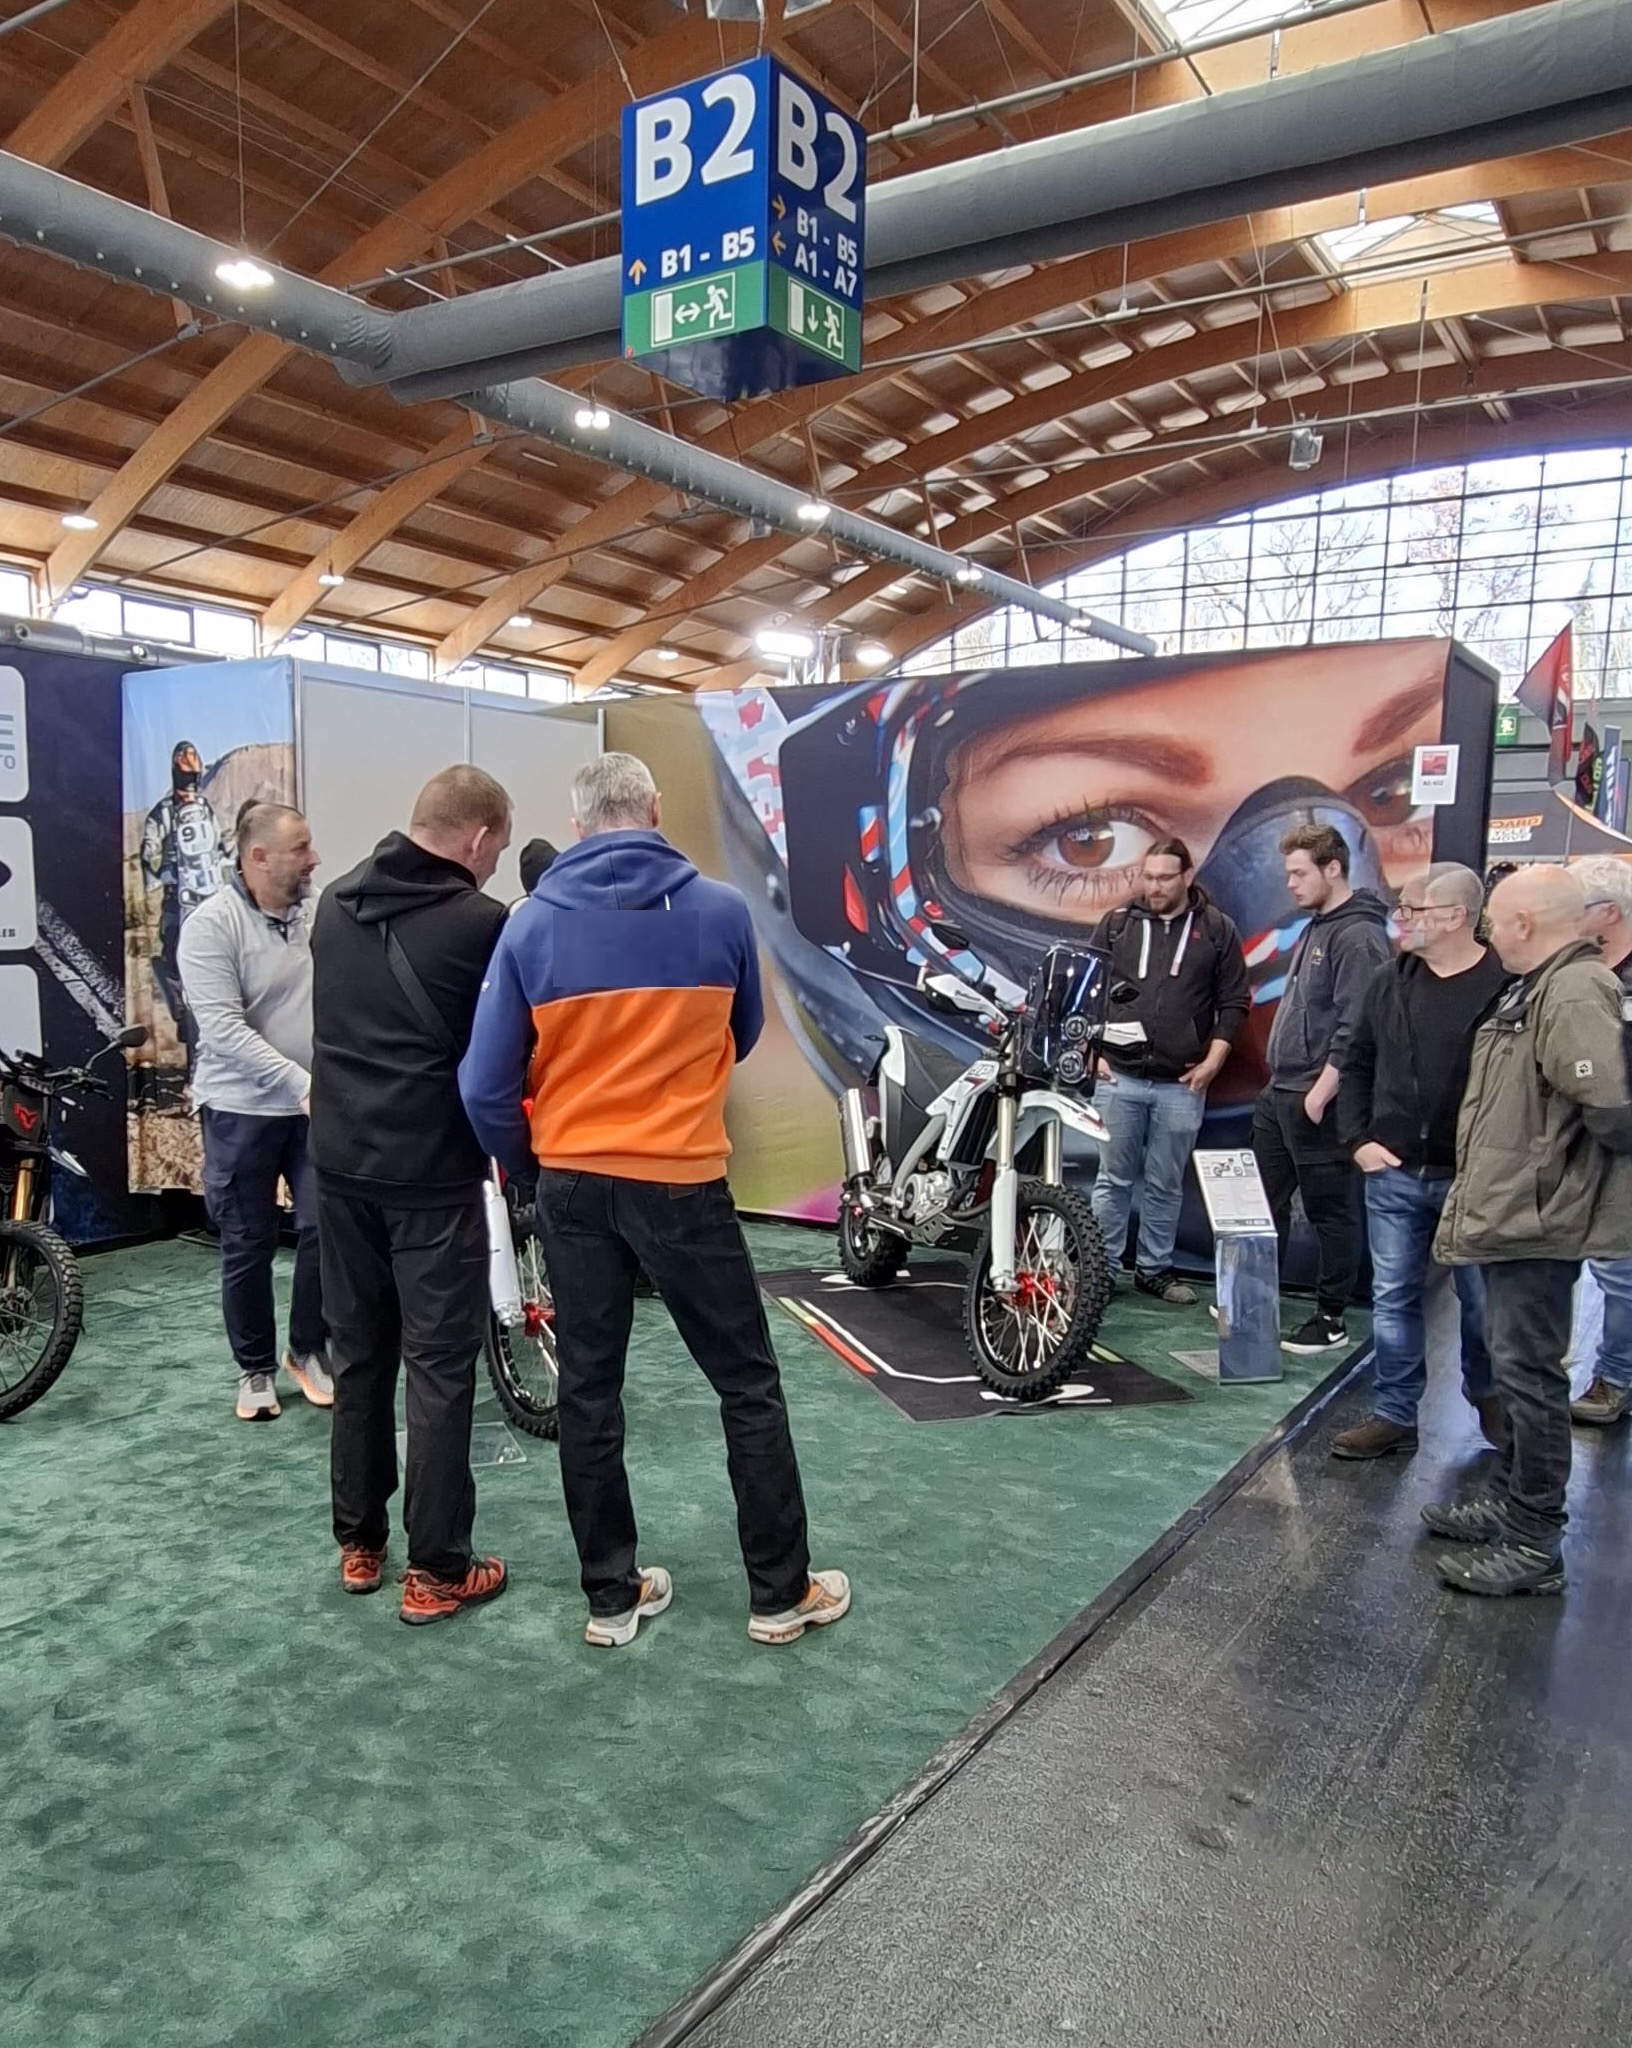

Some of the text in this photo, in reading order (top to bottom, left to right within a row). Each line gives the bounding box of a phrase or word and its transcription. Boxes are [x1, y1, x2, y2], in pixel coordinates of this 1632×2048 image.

[635, 73, 757, 207] B2
[777, 72, 858, 224] B2
[661, 225, 756, 279] B1 - B5
[796, 207, 819, 245] B1
[836, 232, 858, 268] B5
[794, 243, 818, 279] A1
[833, 270, 858, 298] A7
